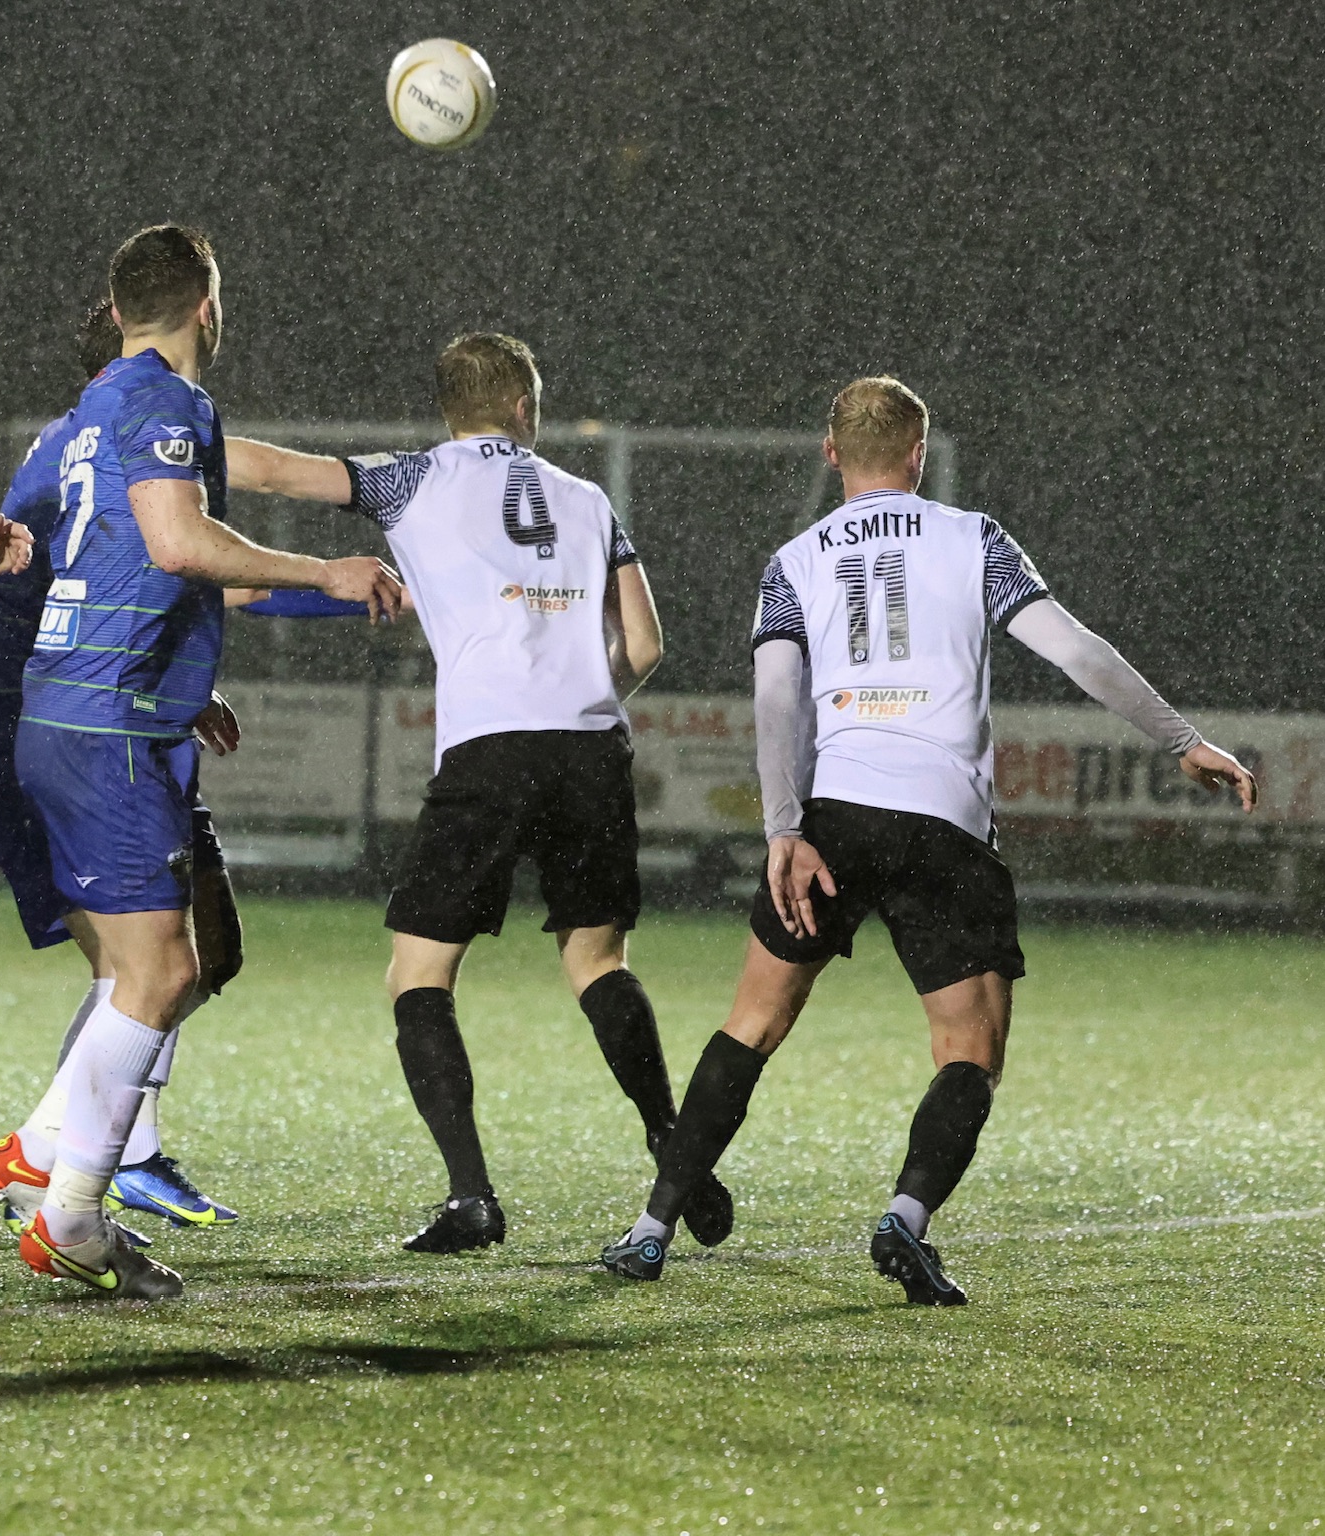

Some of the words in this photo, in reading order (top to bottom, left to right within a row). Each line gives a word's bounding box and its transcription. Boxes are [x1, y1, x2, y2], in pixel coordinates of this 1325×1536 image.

[407, 84, 464, 126] macron
[503, 461, 558, 561] 4
[818, 512, 922, 552] K.SMITH
[526, 587, 586, 599] DAVANTI
[527, 599, 569, 611] TYRES
[835, 549, 911, 666] 11
[857, 703, 908, 715] TYRES
[858, 690, 929, 702] DAVANTI
